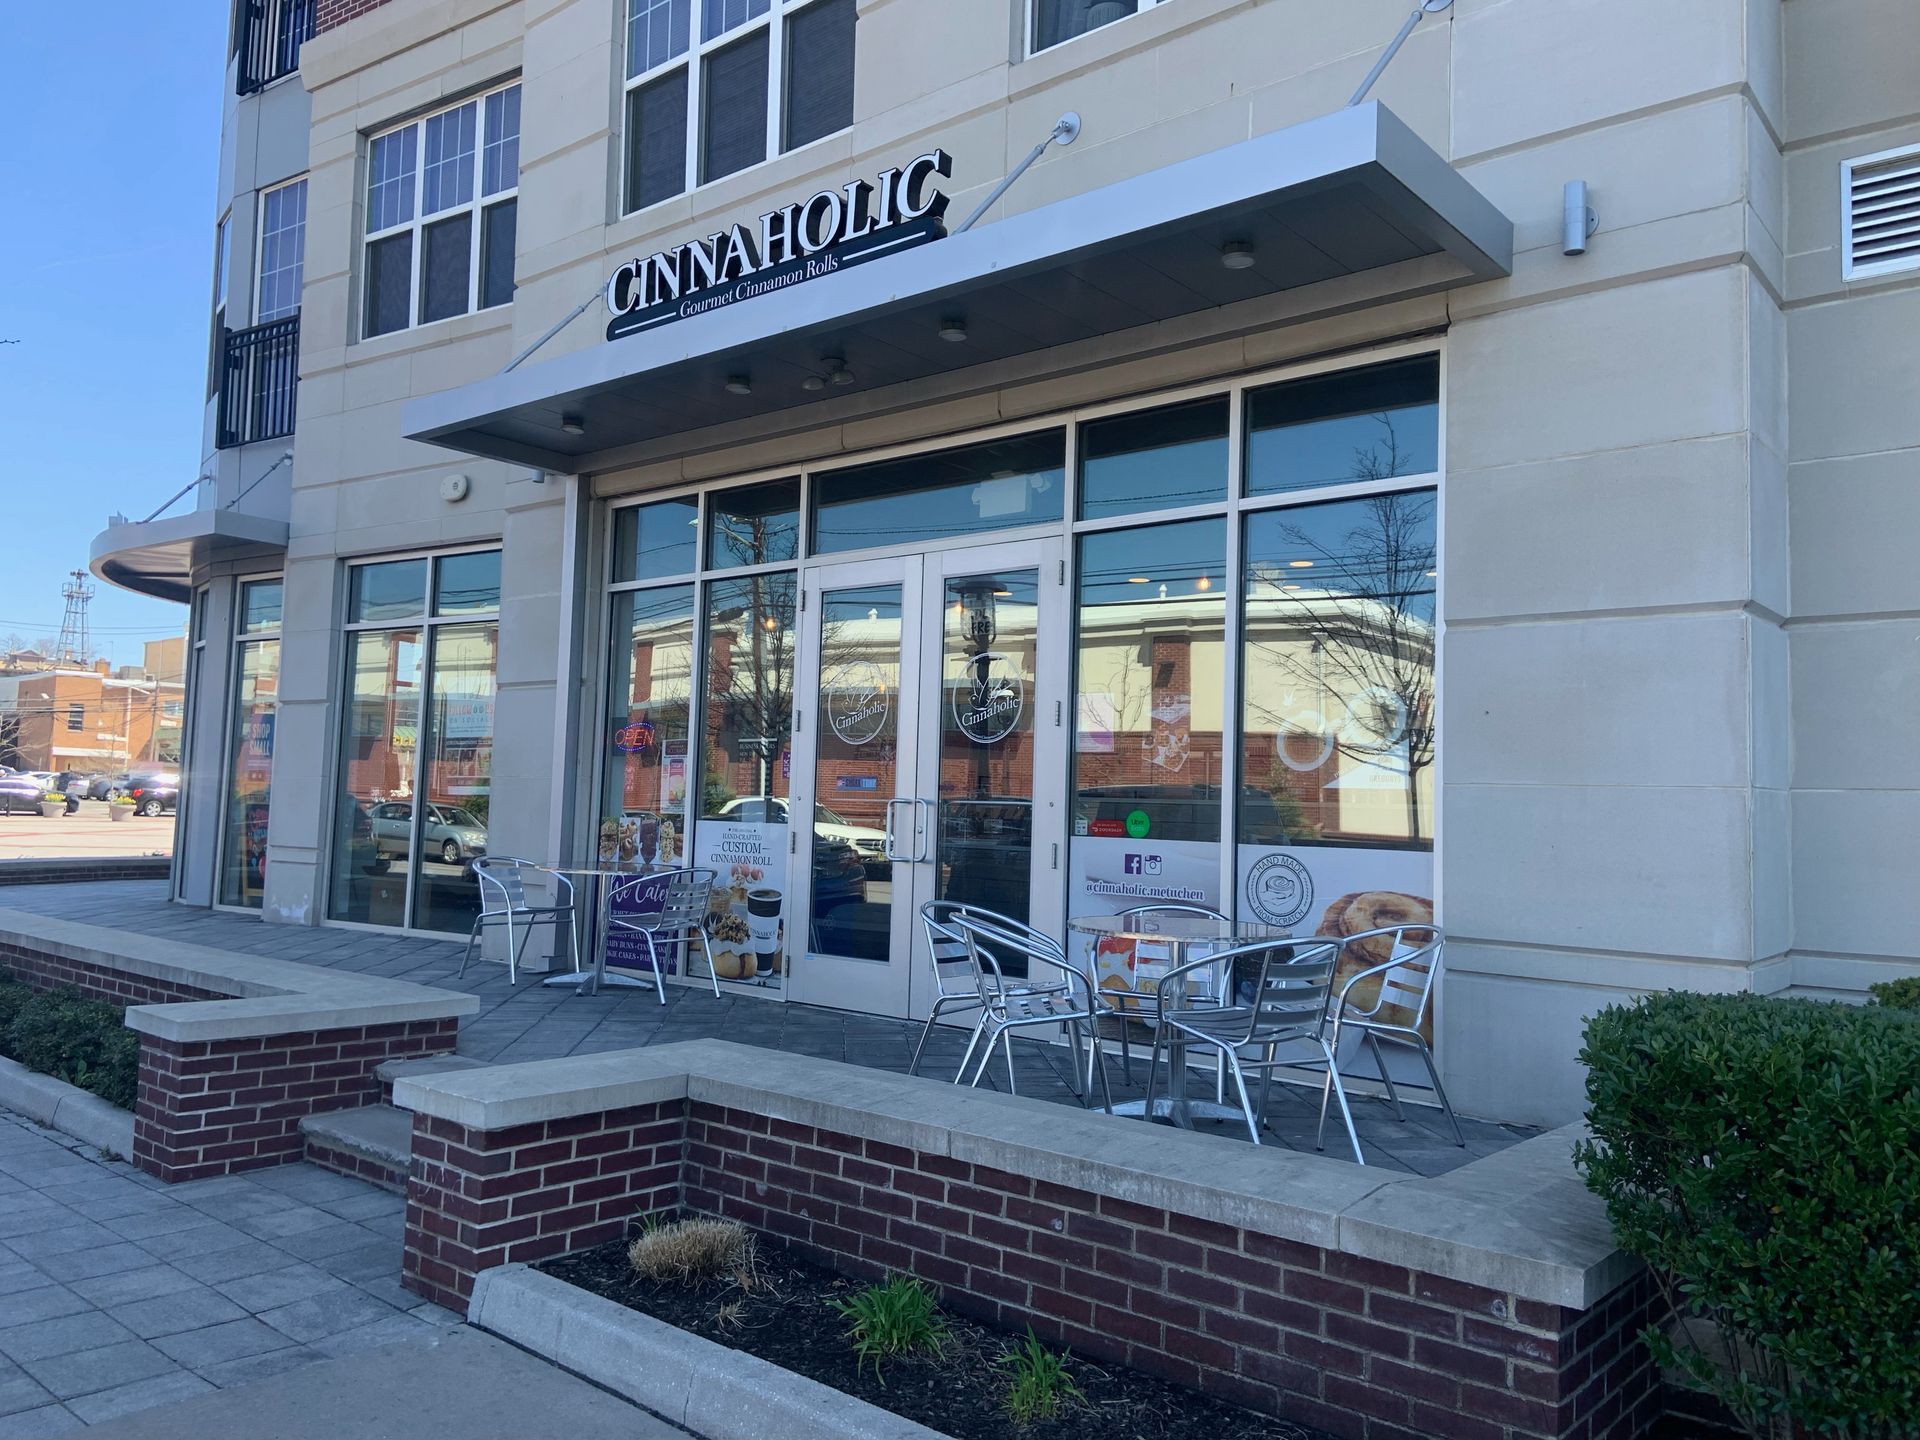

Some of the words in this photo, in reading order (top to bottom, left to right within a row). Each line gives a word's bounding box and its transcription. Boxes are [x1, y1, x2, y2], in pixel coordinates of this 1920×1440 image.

[607, 148, 947, 317] CINNAHOLIC
[680, 288, 734, 317] Gourmet
[735, 269, 803, 300] Cinnamon
[806, 254, 839, 279] Rolls
[836, 700, 886, 729] Cinnaholic
[962, 696, 1021, 726] Cinnaholic
[614, 728, 655, 746] OPEN
[722, 832, 762, 841] HAND-CRAFTED
[721, 840, 762, 854] CUSTOM
[710, 853, 752, 865] CINNAMON
[752, 855, 773, 866] ROLL
[1256, 856, 1280, 873] HAND
[1281, 857, 1305, 876] MADE
[1086, 881, 1204, 900] @cinnaholic.metuchen
[1254, 905, 1273, 923] FROM
[1275, 908, 1305, 925] SCRATCH
